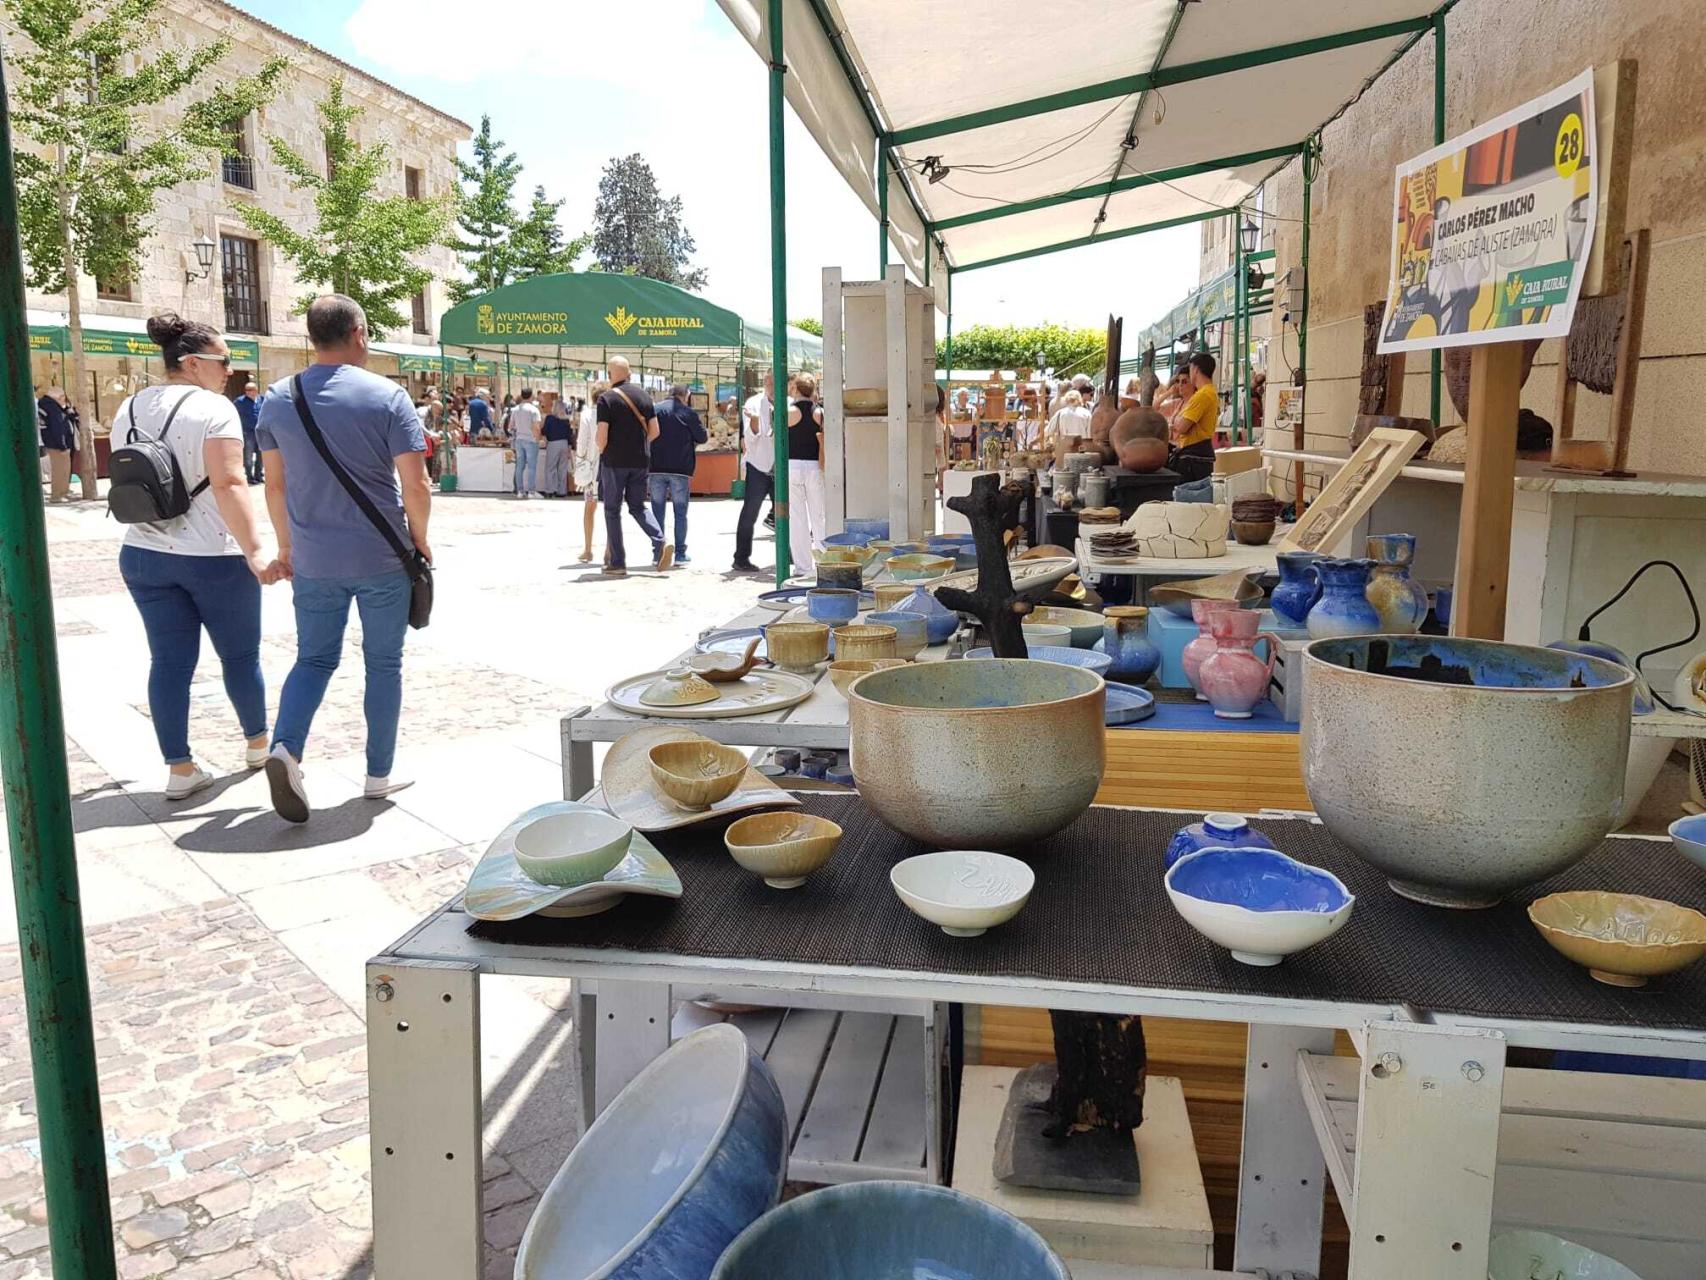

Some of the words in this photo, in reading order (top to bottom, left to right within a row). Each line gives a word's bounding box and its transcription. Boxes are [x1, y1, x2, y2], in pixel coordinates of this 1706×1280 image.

[1558, 127, 1579, 166] 28
[1438, 215, 1466, 240] CARLOS
[1467, 205, 1498, 231] PÉREZ
[1499, 193, 1535, 221] MACHO
[1467, 238, 1479, 259] DE
[1481, 229, 1510, 254] ALISTE
[496, 312, 568, 322] AYUNTAMIENTO
[638, 317, 665, 328] CAJA
[665, 317, 704, 328] RURAL
[497, 322, 512, 334] DE
[516, 322, 568, 334] ZAMORA
